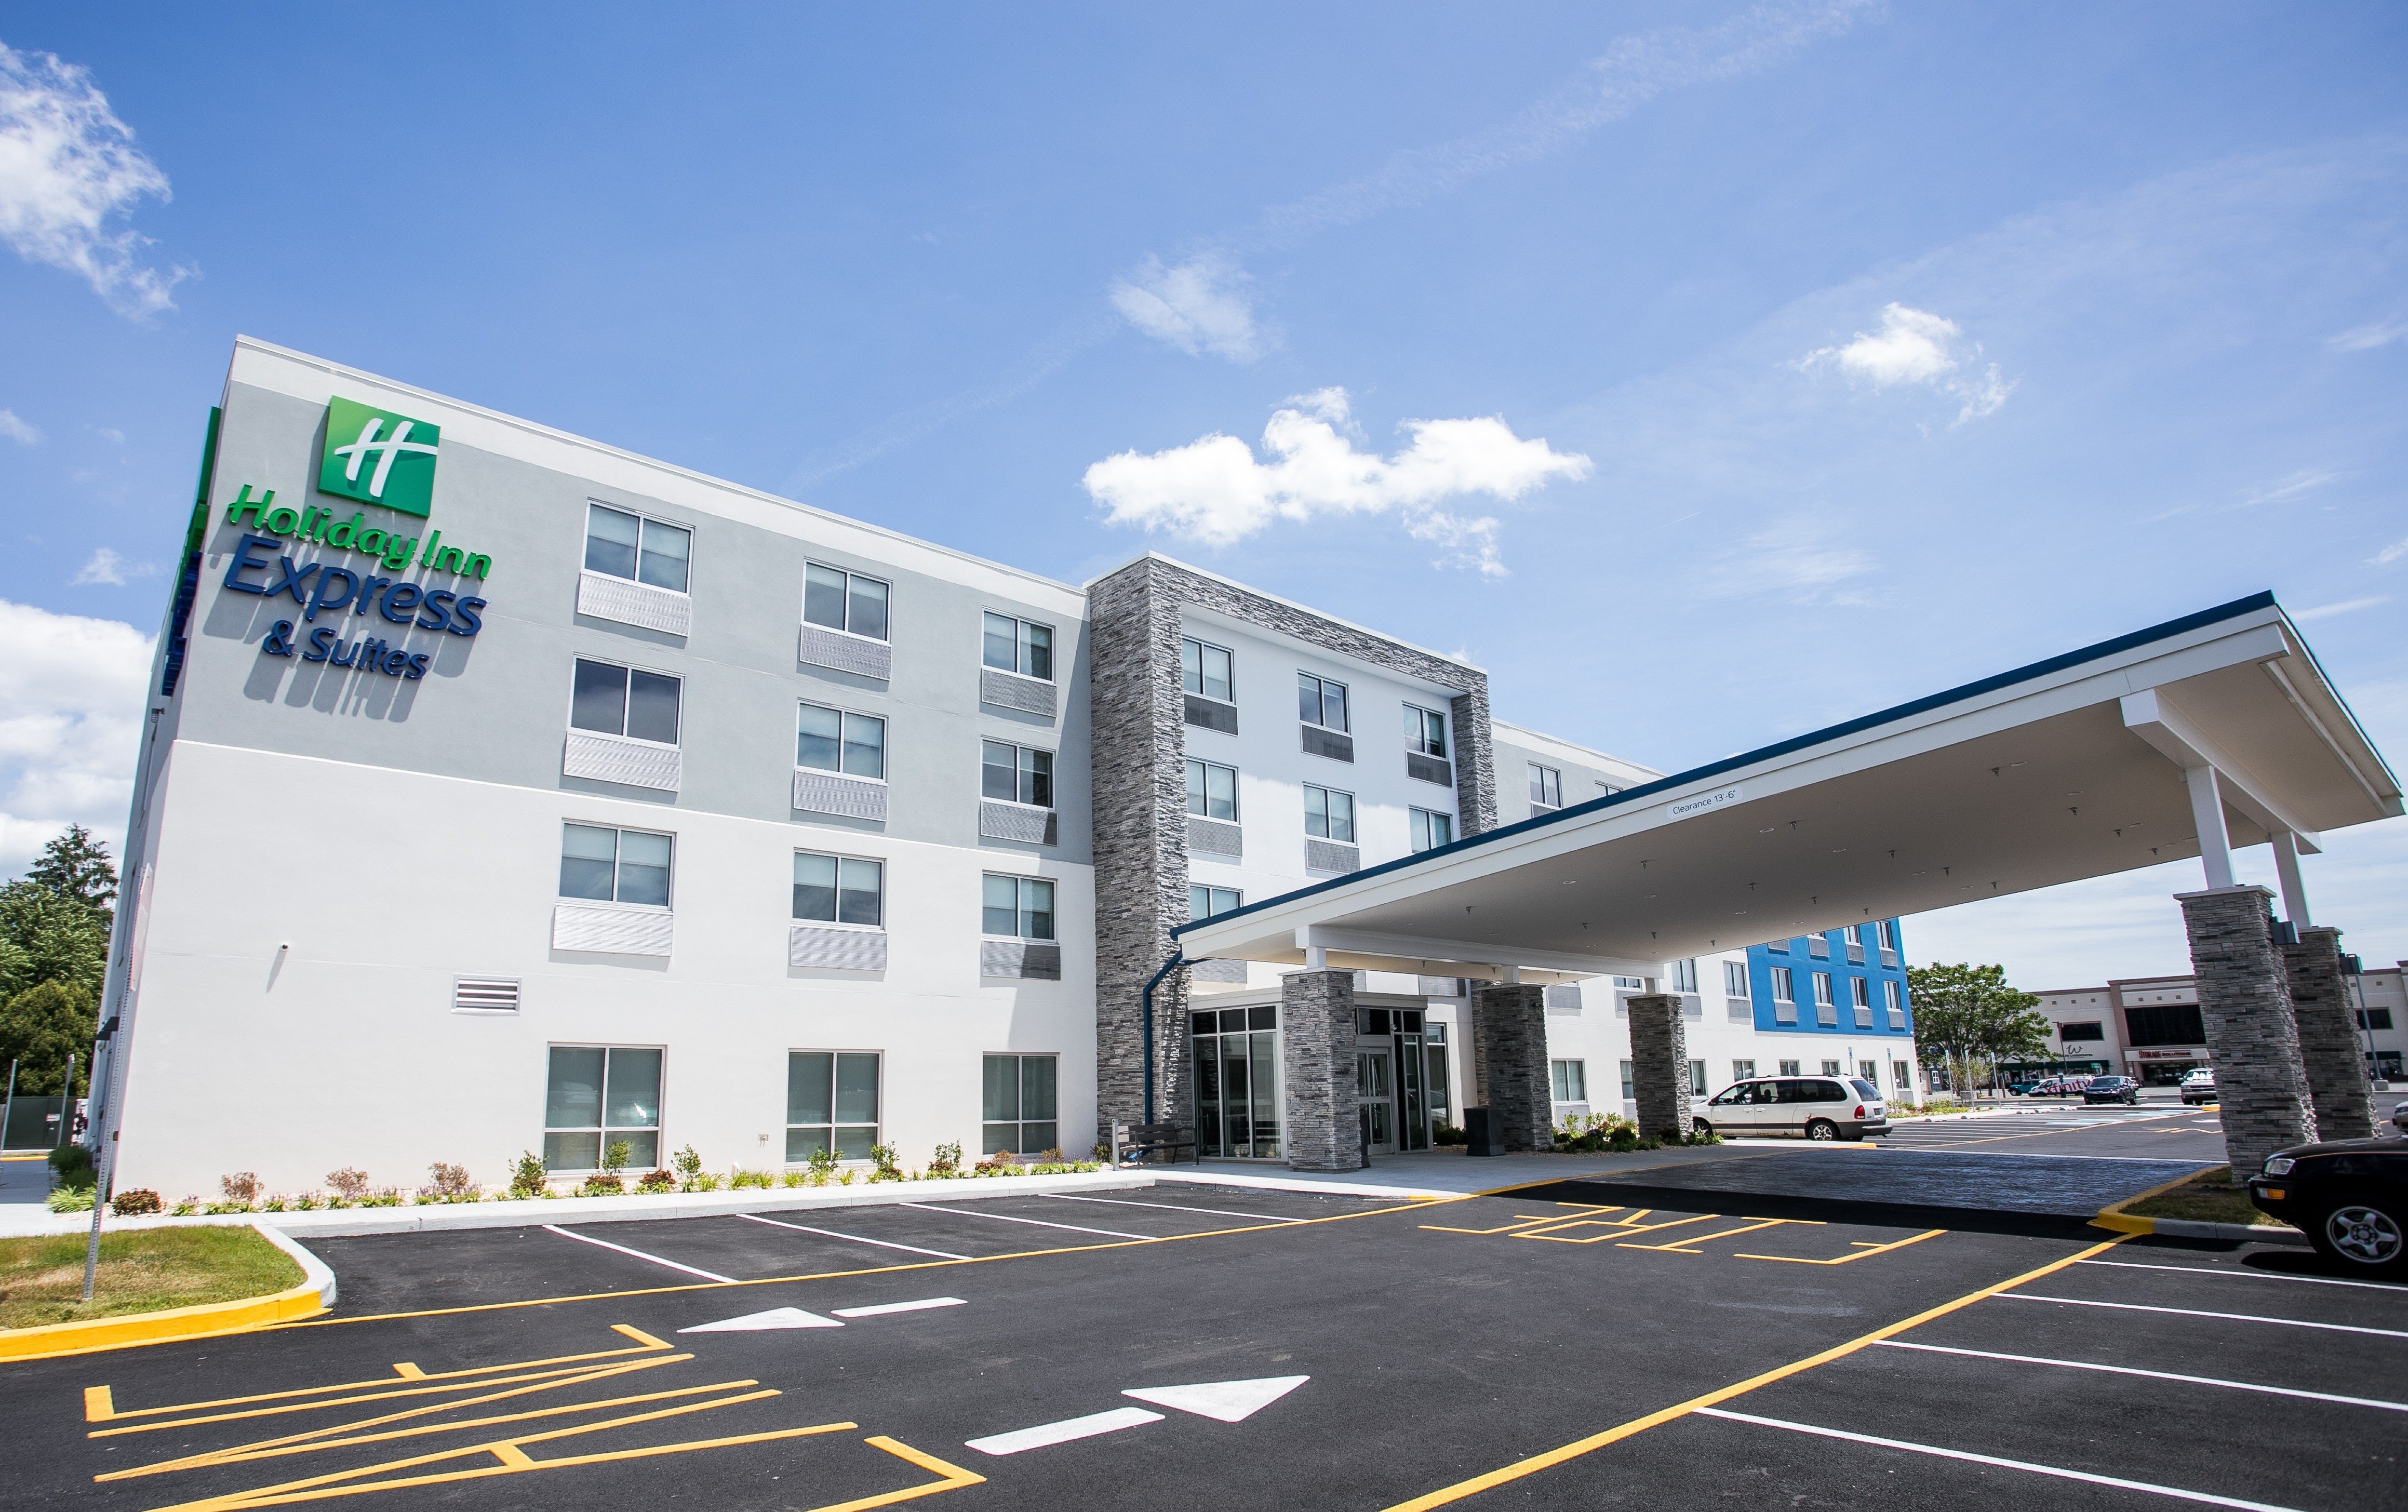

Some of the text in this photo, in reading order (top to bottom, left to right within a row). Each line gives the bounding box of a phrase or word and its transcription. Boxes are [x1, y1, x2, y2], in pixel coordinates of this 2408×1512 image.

[228, 484, 492, 581] Holiday Inn
[223, 532, 488, 637] Express
[262, 619, 431, 680] & Suites
[1673, 790, 1736, 814] Clearance 13'-6"
[2138, 1050, 2162, 1059] STORAGE
[2044, 1079, 2091, 1093] xfinity
